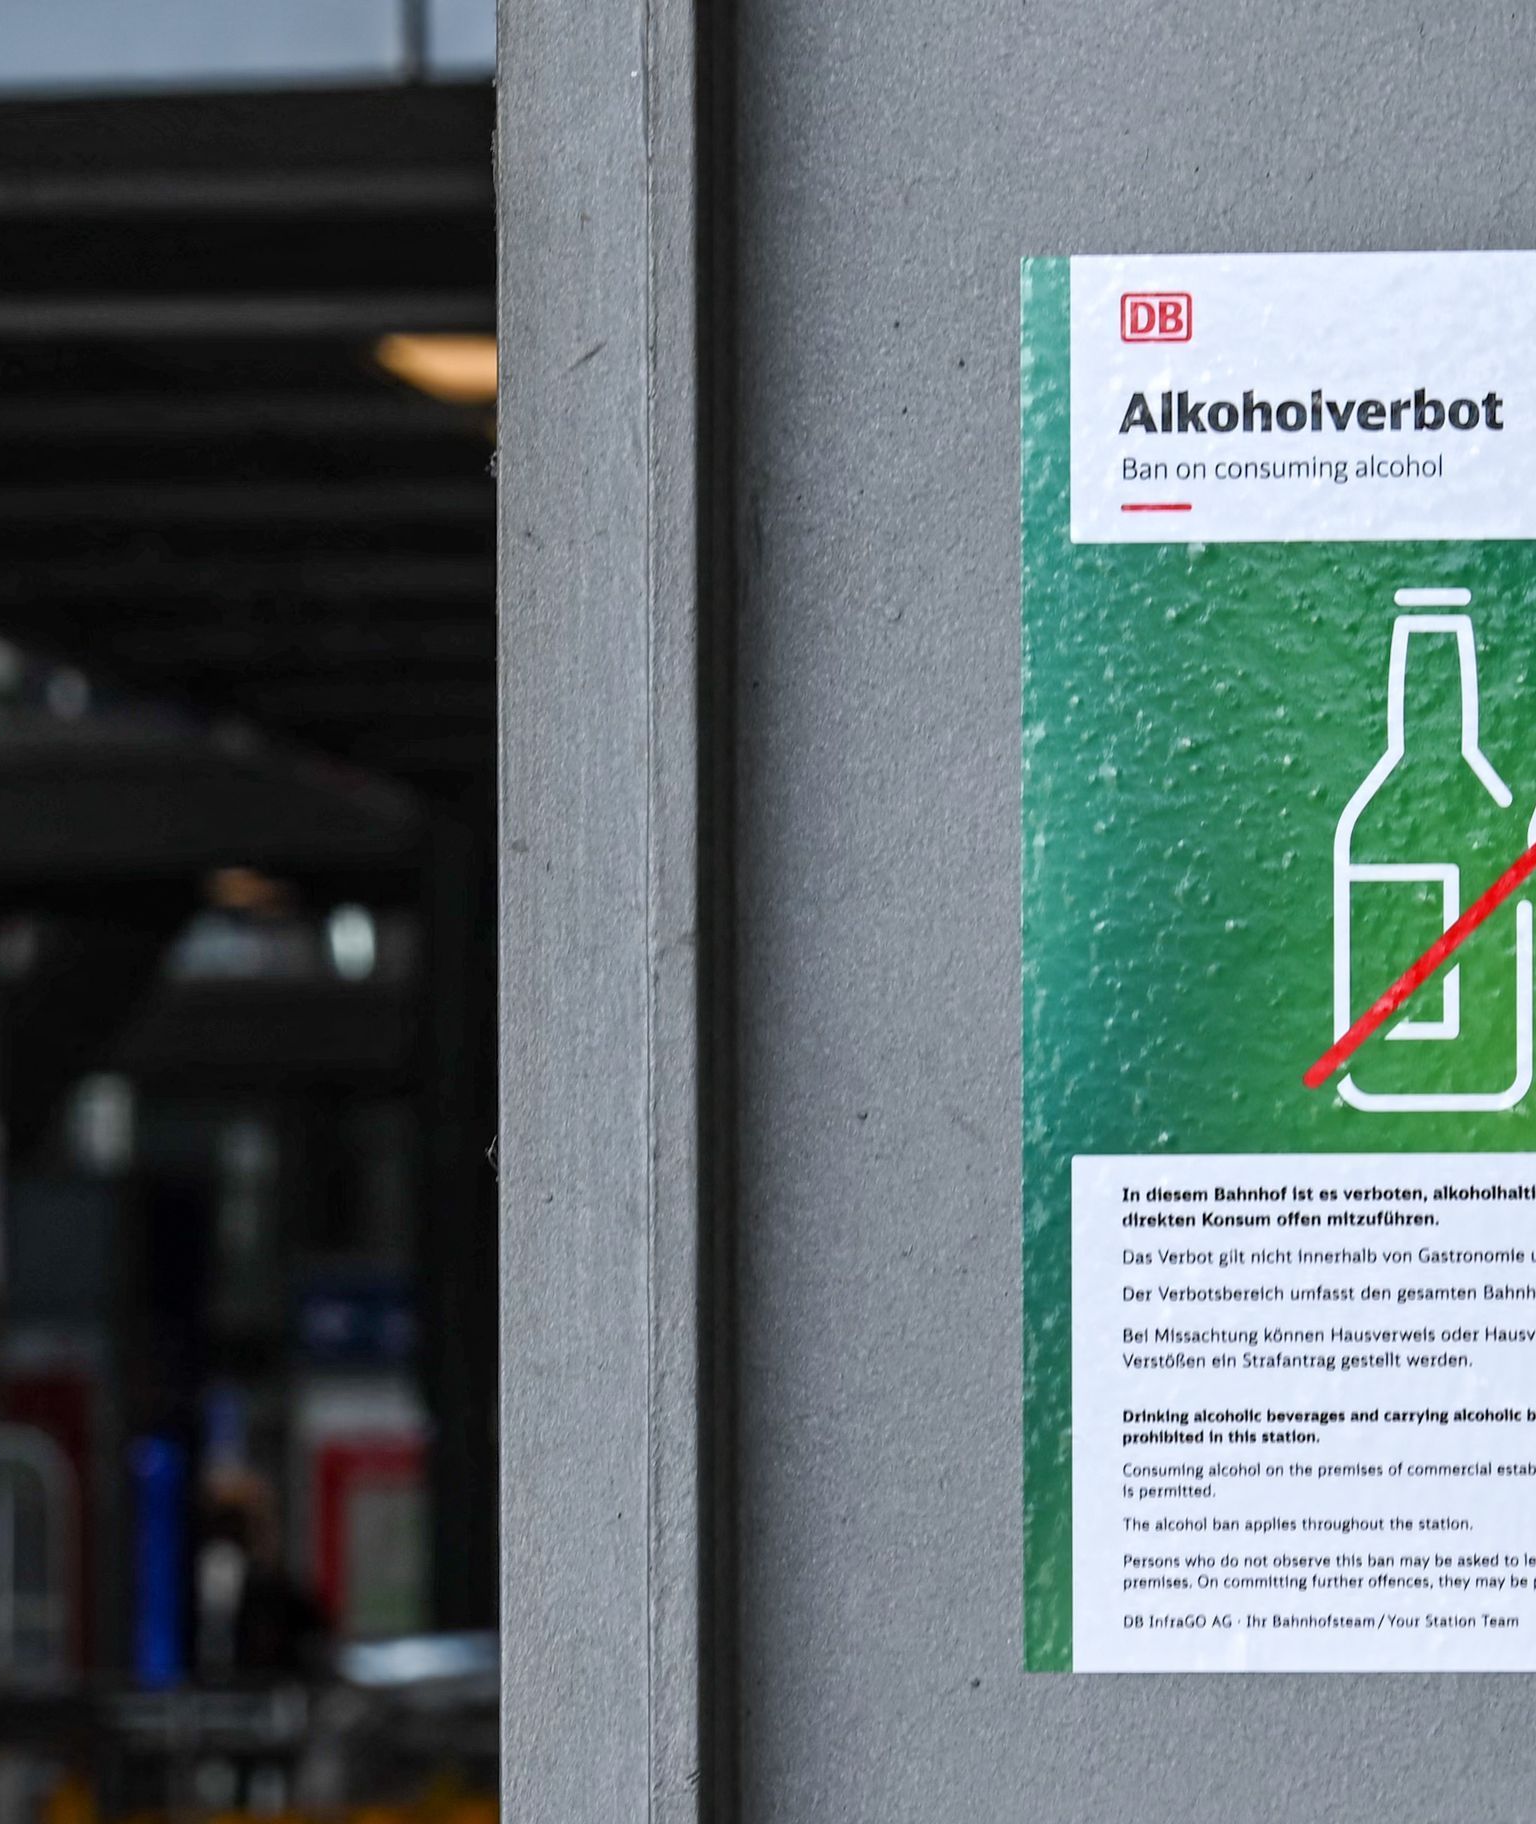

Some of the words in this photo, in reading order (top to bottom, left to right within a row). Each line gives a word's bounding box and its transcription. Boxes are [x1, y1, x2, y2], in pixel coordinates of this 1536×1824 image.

[1128, 299, 1185, 336] DB
[1119, 388, 1505, 434] Alkoholverbot
[1121, 456, 1169, 481] Ban
[1175, 462, 1207, 480] on
[1214, 455, 1348, 485] consuming
[1354, 453, 1445, 479] alcohol
[1121, 1186, 1141, 1203] In
[1145, 1186, 1209, 1203] diesem
[1213, 1185, 1288, 1203] Bahnhof
[1291, 1184, 1315, 1202] ist
[1318, 1188, 1339, 1202] es
[1342, 1184, 1429, 1204] verboten,
[1121, 1211, 1197, 1229] direkten
[1201, 1211, 1272, 1228] Konsum
[1276, 1210, 1322, 1227] offen
[1326, 1209, 1440, 1227] mitzuführen.
[1122, 1248, 1153, 1266] Das
[1157, 1248, 1214, 1265] Verbot
[1218, 1248, 1246, 1269] gilt
[1250, 1247, 1293, 1264] nicht
[1297, 1247, 1378, 1264] innerhalb
[1381, 1250, 1413, 1264] von
[1417, 1247, 1526, 1264] Gastronomie
[1122, 1285, 1153, 1303] Der
[1157, 1285, 1284, 1303] Verbotsbereich
[1290, 1283, 1356, 1301] umfasst
[1360, 1284, 1392, 1301] den
[1396, 1286, 1477, 1305] gesamten
[1122, 1327, 1149, 1344] Bei
[1154, 1327, 1259, 1348] Missachtung
[1263, 1326, 1325, 1343] können
[1330, 1326, 1436, 1343] Hausverweis
[1440, 1325, 1480, 1343] oder
[1122, 1352, 1206, 1370] Verstößen
[1211, 1353, 1237, 1369] ein
[1242, 1351, 1336, 1372] Strafantrag
[1340, 1351, 1402, 1372] gestellt
[1406, 1351, 1473, 1368] werden.
[1122, 1408, 1190, 1427] Drinking
[1193, 1408, 1263, 1424] alcoholic
[1266, 1407, 1346, 1426] beverages
[1349, 1407, 1380, 1423] and
[1383, 1407, 1450, 1426] carrying
[1452, 1407, 1522, 1423] alcoholic
[1122, 1429, 1205, 1448] prohibited
[1208, 1429, 1224, 1445] in
[1227, 1429, 1257, 1445] this
[1261, 1428, 1321, 1444] station.
[1122, 1462, 1205, 1481] Consuming
[1208, 1462, 1261, 1478] alcohol
[1265, 1464, 1284, 1477] on
[1288, 1461, 1313, 1477] the
[1317, 1461, 1384, 1479] premises
[1387, 1461, 1404, 1477] of
[1406, 1461, 1492, 1477] commercial
[1122, 1483, 1135, 1499] is
[1138, 1483, 1216, 1501] permitted.
[1122, 1516, 1150, 1532] The
[1154, 1516, 1208, 1532] alcohol
[1212, 1517, 1240, 1532] ban
[1244, 1515, 1297, 1534] applies
[1301, 1516, 1385, 1535] throughout
[1389, 1515, 1414, 1531] the
[1418, 1516, 1474, 1531] station.
[1123, 1553, 1181, 1569] Persons
[1184, 1553, 1216, 1569] who
[1220, 1553, 1239, 1569] do
[1243, 1555, 1269, 1569] not
[1272, 1552, 1331, 1568] observe
[1335, 1553, 1363, 1568] this
[1367, 1552, 1395, 1568] ban
[1399, 1556, 1431, 1571] may
[1434, 1552, 1453, 1568] be
[1456, 1552, 1500, 1568] asked
[1503, 1554, 1520, 1568] to
[1122, 1575, 1193, 1593] premises.
[1197, 1574, 1219, 1589] On
[1223, 1573, 1308, 1592] committing
[1311, 1573, 1365, 1589] further
[1367, 1573, 1434, 1590] offences,
[1438, 1573, 1471, 1592] they
[1475, 1576, 1506, 1592] may
[1510, 1573, 1529, 1589] be
[1123, 1614, 1145, 1629] DB
[1148, 1614, 1207, 1629] InfraGO
[1211, 1614, 1233, 1629] AG
[1246, 1614, 1268, 1629] Ihr
[1425, 1614, 1477, 1628] Station
[1482, 1614, 1520, 1628] Team
